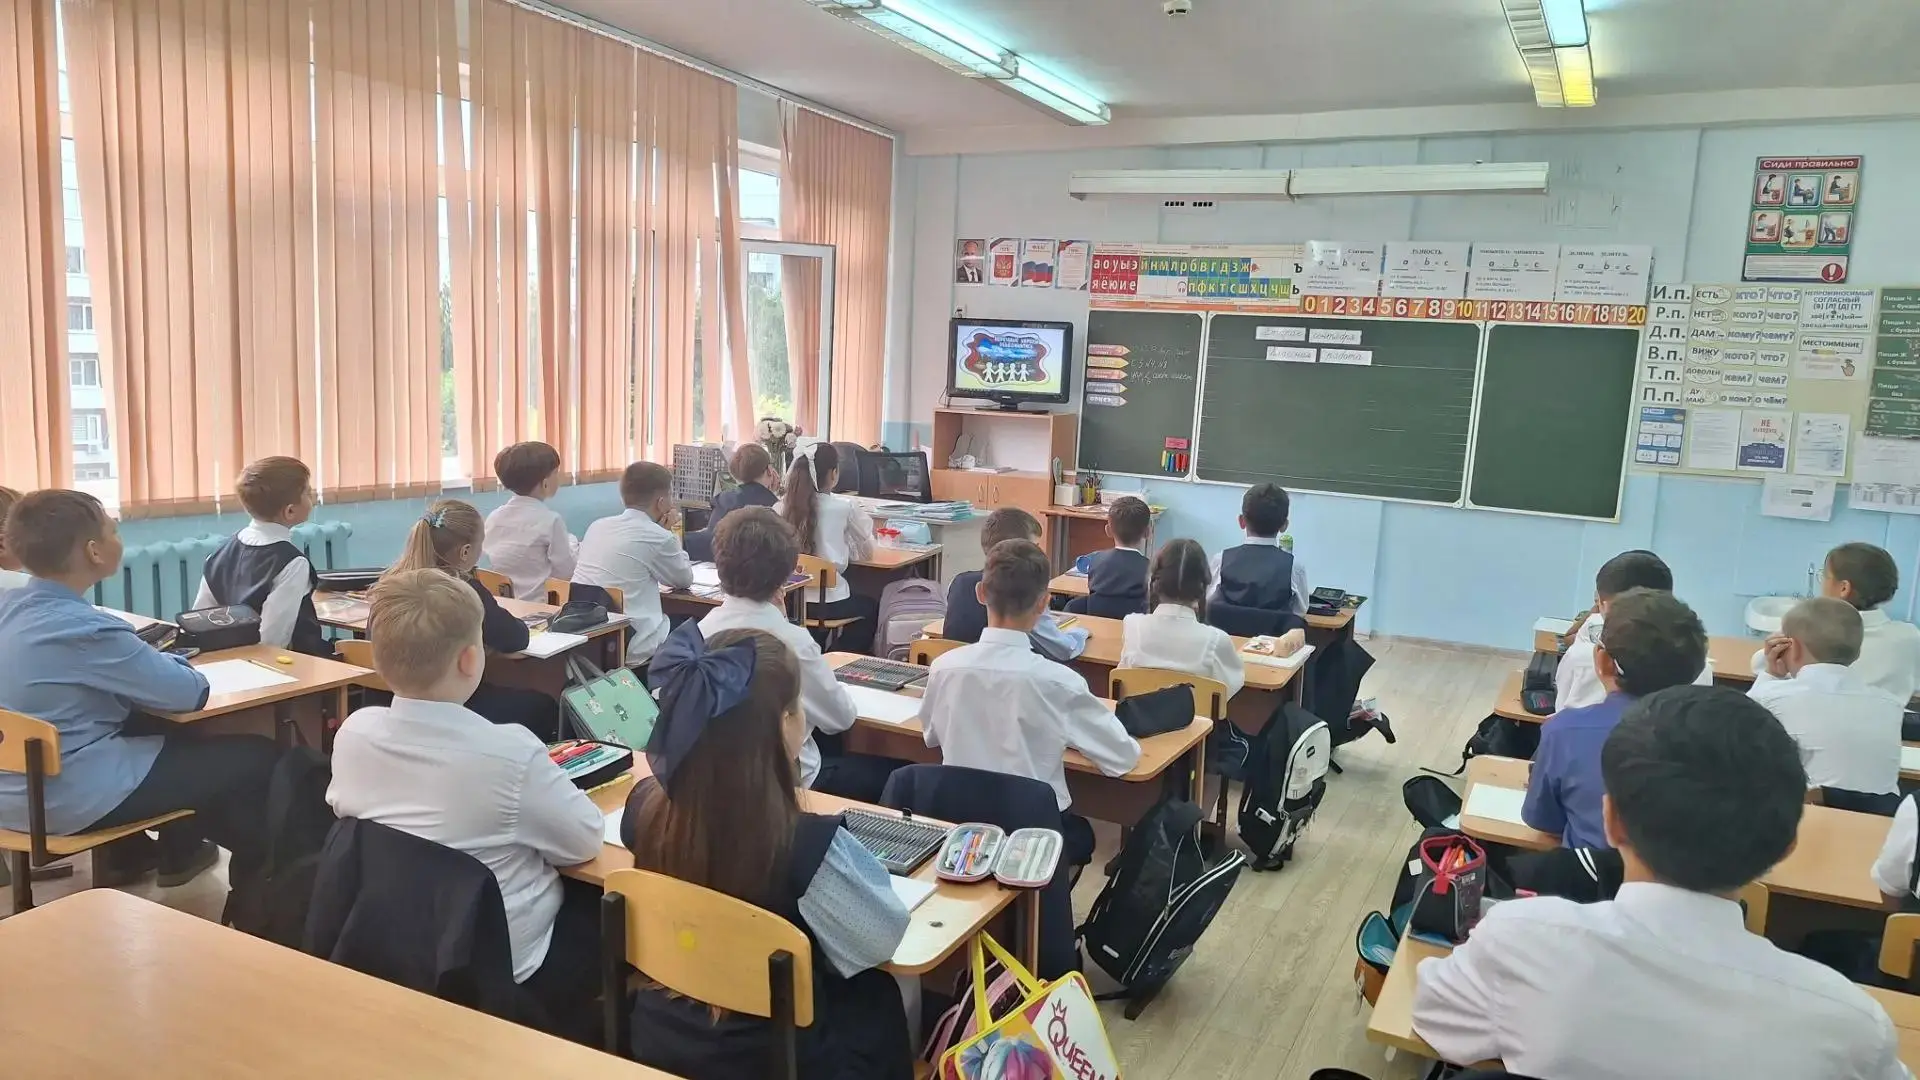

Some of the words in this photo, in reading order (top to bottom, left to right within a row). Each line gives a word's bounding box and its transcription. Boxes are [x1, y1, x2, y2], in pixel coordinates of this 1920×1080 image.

[1796, 160, 1854, 169] правильно
[1654, 285, 1690, 300] И.п.
[1696, 290, 1719, 298] ЕСТЬ
[1736, 288, 1764, 299] кто?
[1305, 297, 1316, 312] 0
[1321, 298, 1329, 312] 1
[1334, 297, 1346, 314] 2
[1350, 298, 1360, 313] 3
[1362, 298, 1376, 314] 4
[1380, 299, 1392, 314] 5
[1396, 299, 1408, 315] 6
[1412, 300, 1424, 315] 7
[1428, 300, 1440, 316] 8
[1443, 300, 1455, 316] 9
[1457, 300, 1472, 318] 10
[1476, 302, 1488, 319] 11
[1491, 302, 1506, 320] 12
[1509, 302, 1524, 320] 13
[1526, 303, 1541, 320] 14
[1543, 304, 1558, 321] 15
[1560, 304, 1575, 322] 16
[1576, 305, 1592, 322] 17
[1594, 305, 1609, 323] 18
[1611, 306, 1627, 324] 19
[1628, 306, 1646, 324] 20
[1656, 307, 1685, 319] Р.п.
[1694, 310, 1710, 318] НЕТ
[1733, 310, 1764, 319] кого?
[1767, 311, 1799, 320] чего?
[1650, 326, 1685, 339] Д.п.
[1728, 331, 1761, 340] кому?
[1802, 340, 1860, 348] МЕСТОИМЕНИЕ
[1648, 346, 1682, 361] В.п.
[1692, 347, 1719, 355] ВИЖУ
[1724, 352, 1755, 360] кого?
[1761, 353, 1785, 361] что?
[1647, 366, 1680, 380] Т.п.
[1686, 368, 1720, 376] ДОВОЛЕН
[1724, 374, 1752, 382] кем?
[1759, 376, 1787, 384] чем?
[1643, 388, 1680, 402] П.п.
